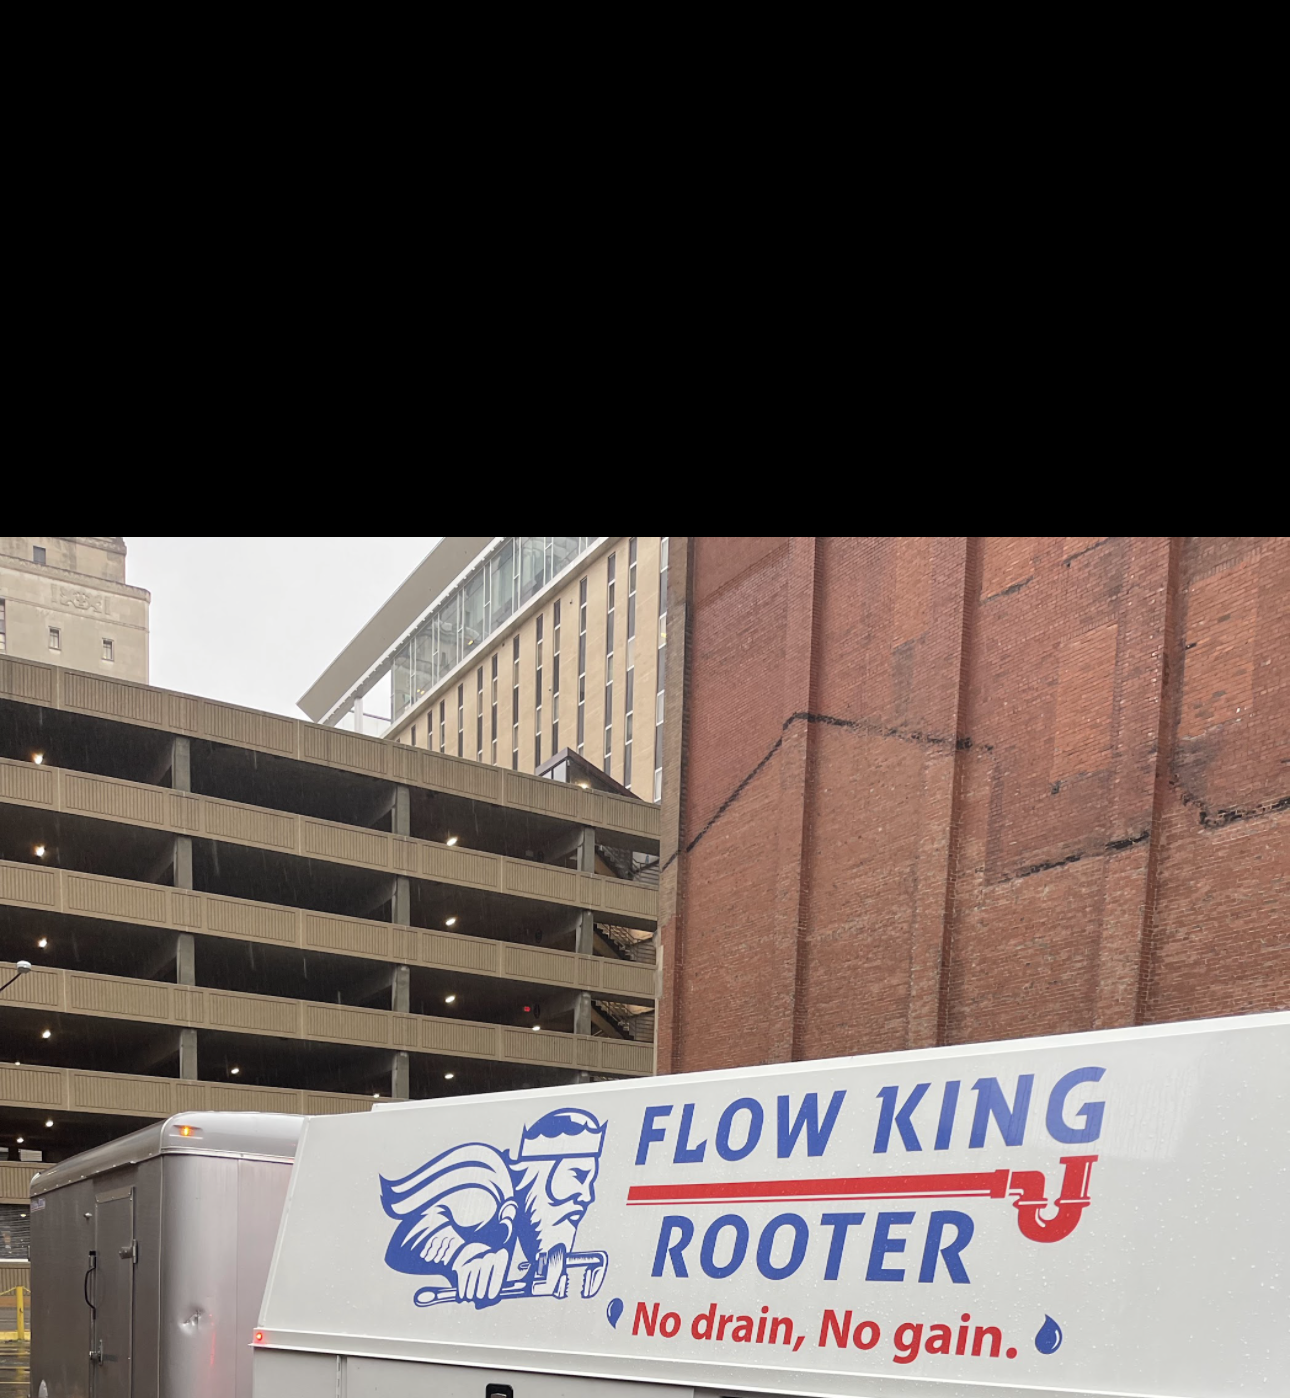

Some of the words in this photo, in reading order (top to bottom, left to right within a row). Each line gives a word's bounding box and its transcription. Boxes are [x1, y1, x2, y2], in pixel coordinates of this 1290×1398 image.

[635, 1090, 847, 1166] FLOW
[872, 1066, 1106, 1154] KING
[651, 1211, 975, 1284] ROOTER
[632, 1301, 682, 1339] No
[691, 1302, 806, 1352] drain,
[818, 1309, 881, 1351] No
[892, 1312, 1018, 1365] gain.
